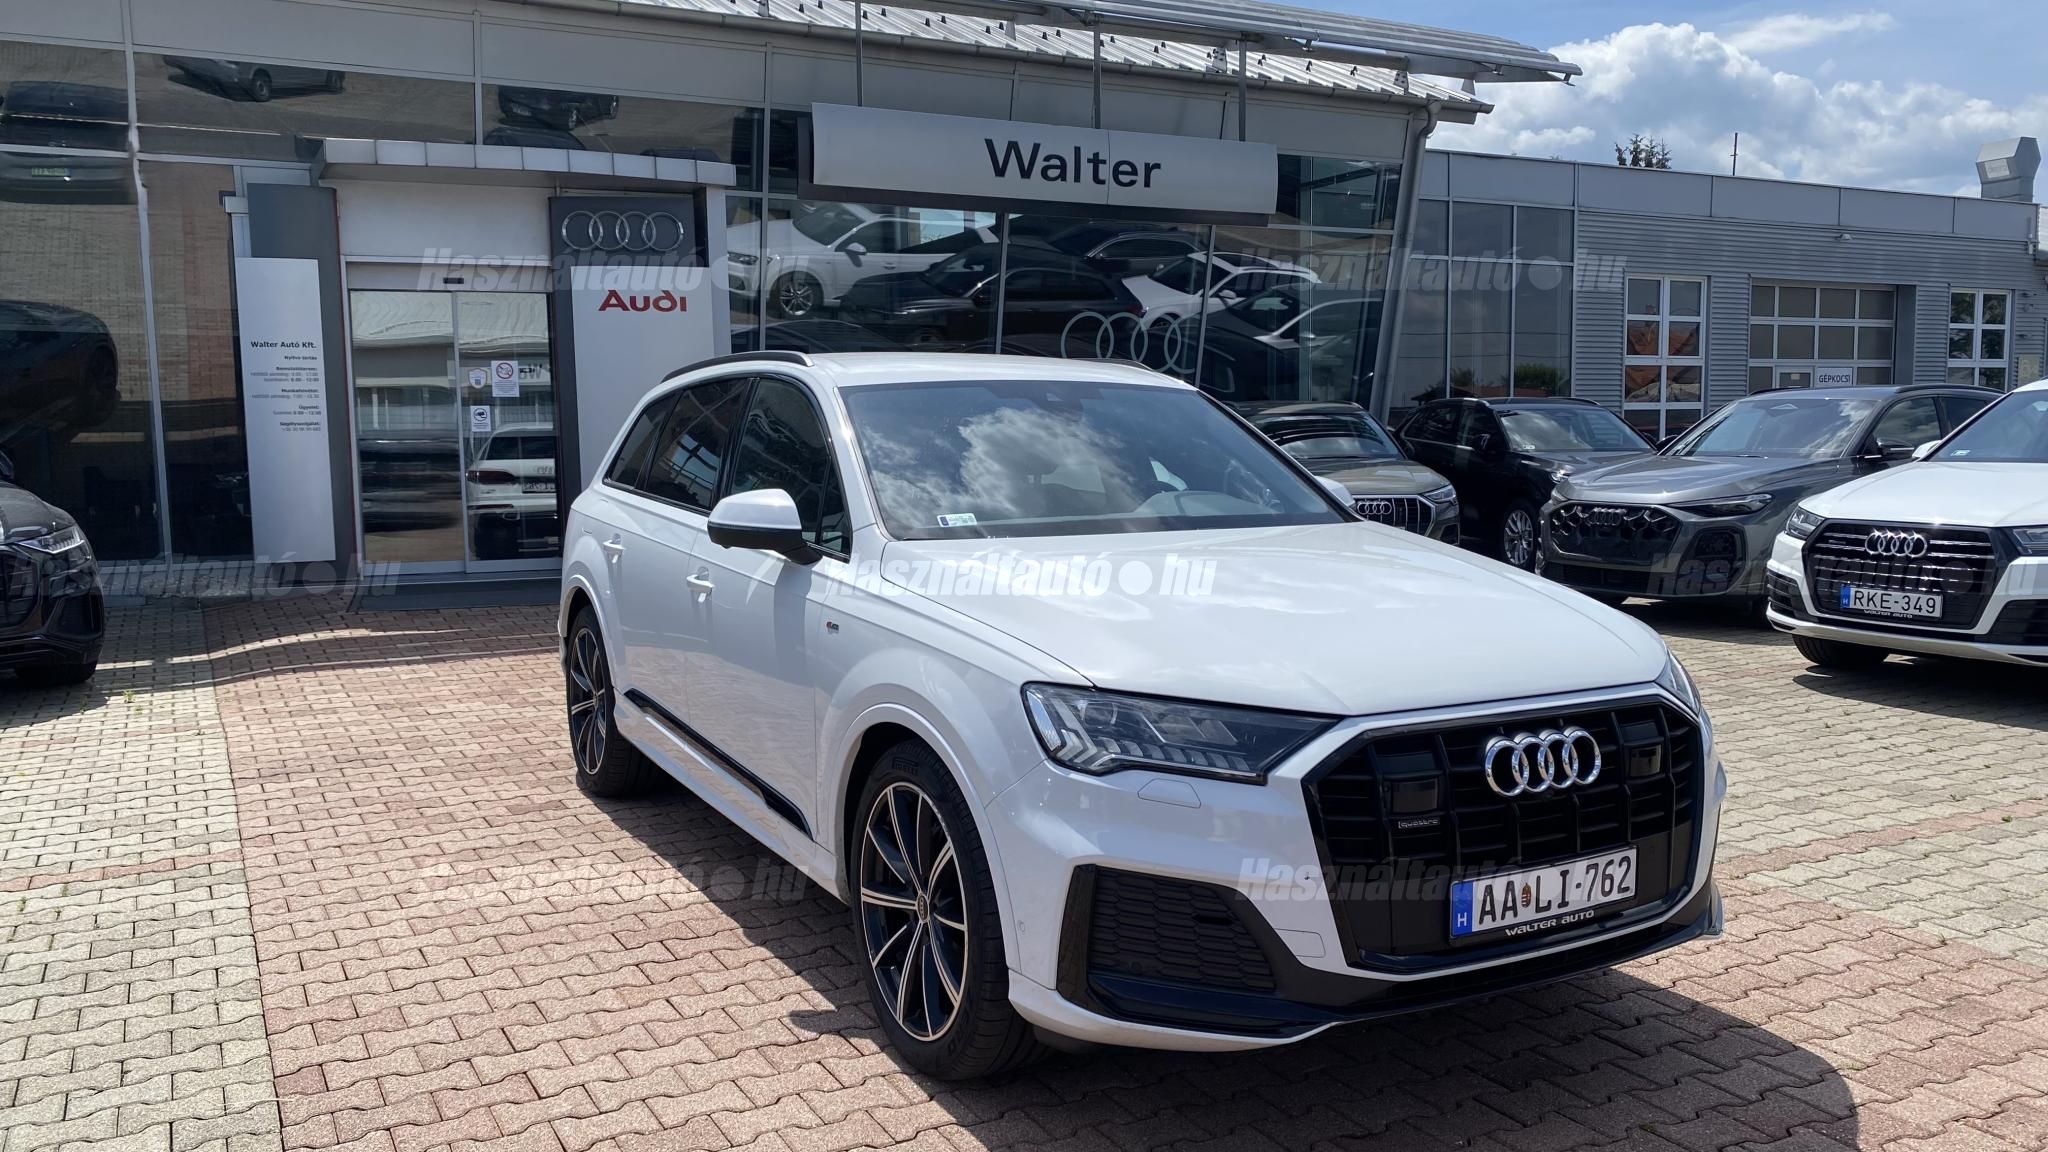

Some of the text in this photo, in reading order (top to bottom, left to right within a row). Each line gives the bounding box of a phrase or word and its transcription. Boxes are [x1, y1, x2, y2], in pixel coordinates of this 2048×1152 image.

[984, 138, 1161, 188] Walter
[598, 289, 687, 312] Audi
[250, 341, 317, 349] Walter Autó Kft.
[1853, 590, 1936, 614] RKE-349
[1457, 912, 1467, 928] H
